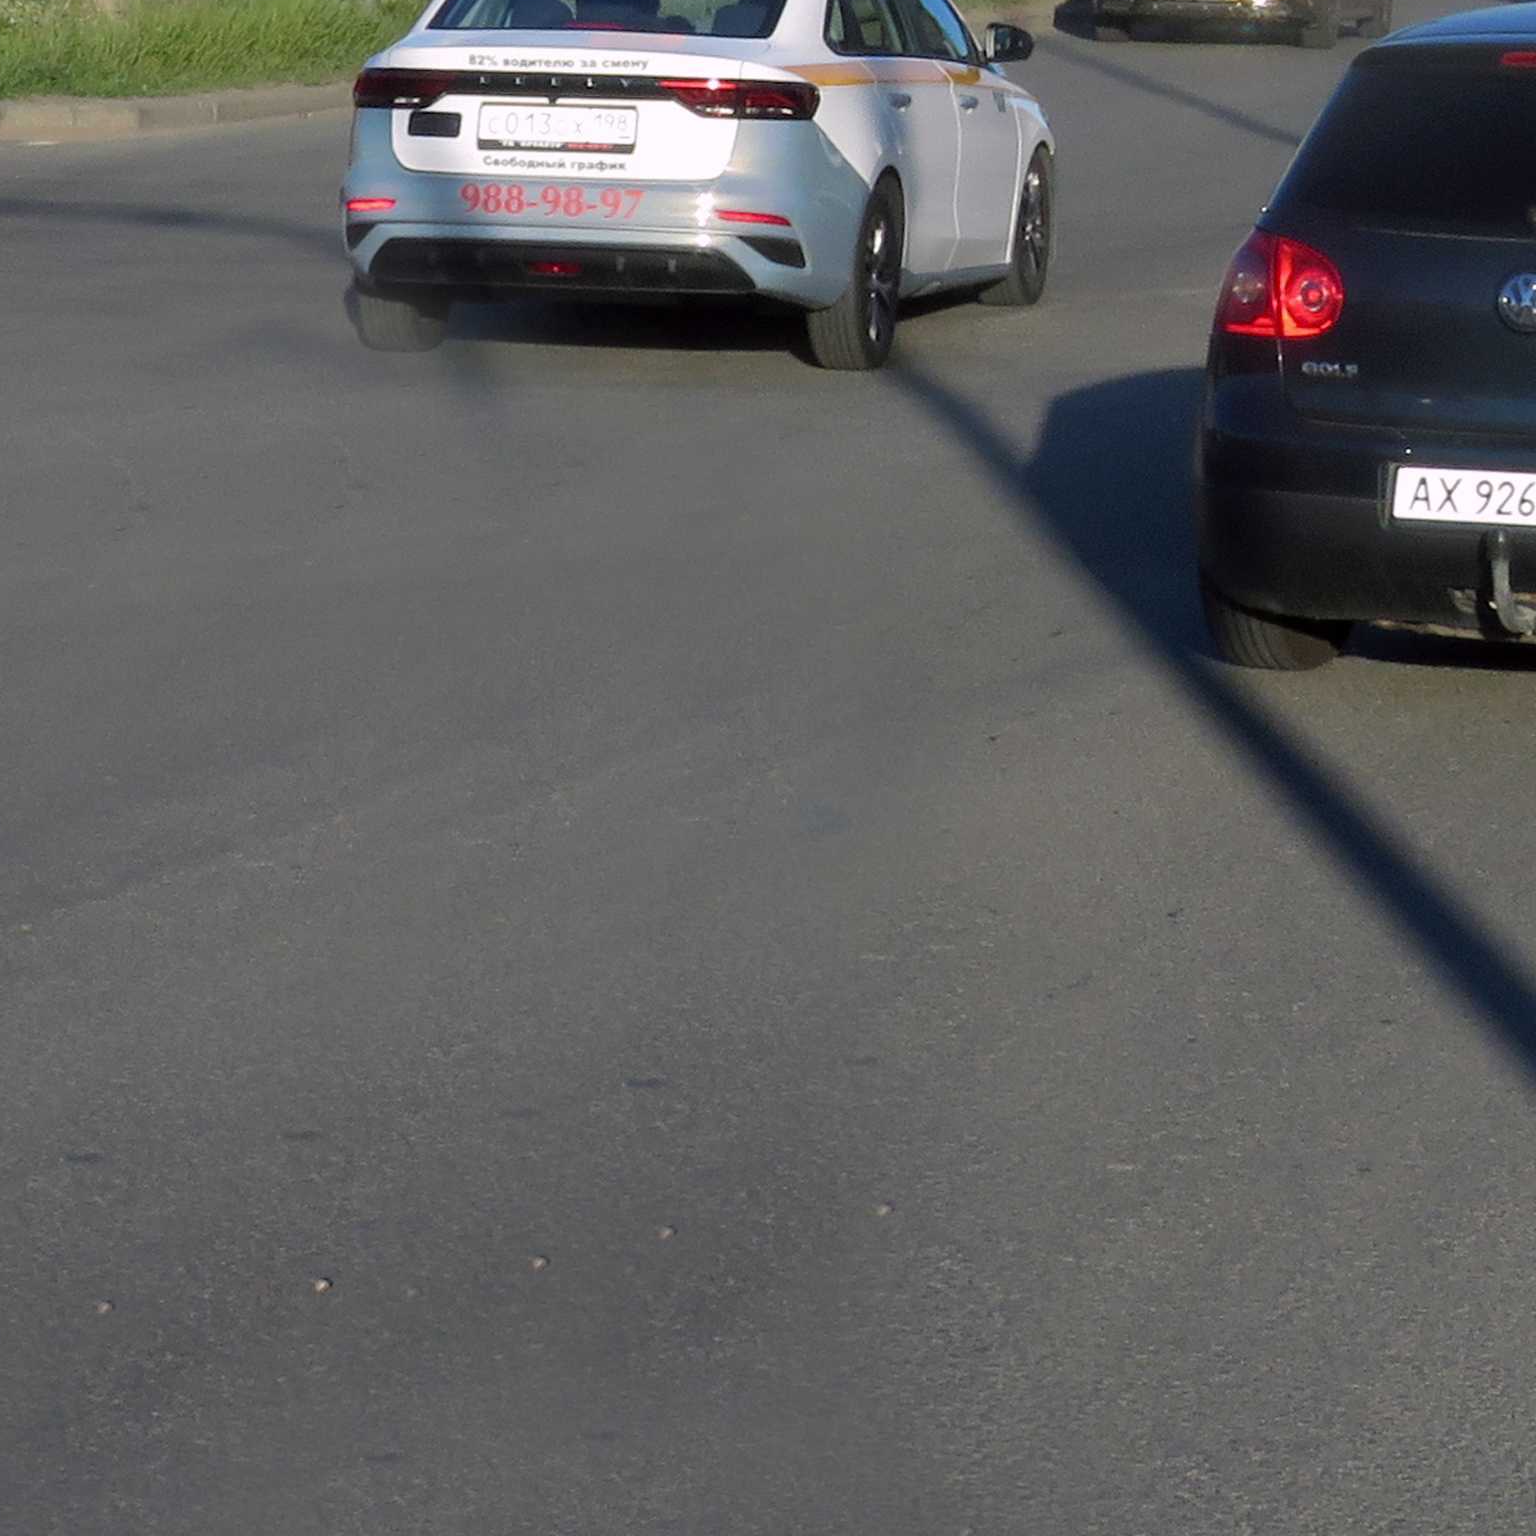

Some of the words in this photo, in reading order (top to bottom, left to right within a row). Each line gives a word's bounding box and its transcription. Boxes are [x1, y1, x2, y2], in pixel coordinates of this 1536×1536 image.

[468, 54, 499, 66] 82%
[502, 57, 575, 70] водителю
[580, 59, 597, 69] за
[601, 58, 649, 71] смену
[482, 154, 567, 170] Свободный
[570, 159, 627, 172] график
[460, 181, 647, 220] 988-98-97
